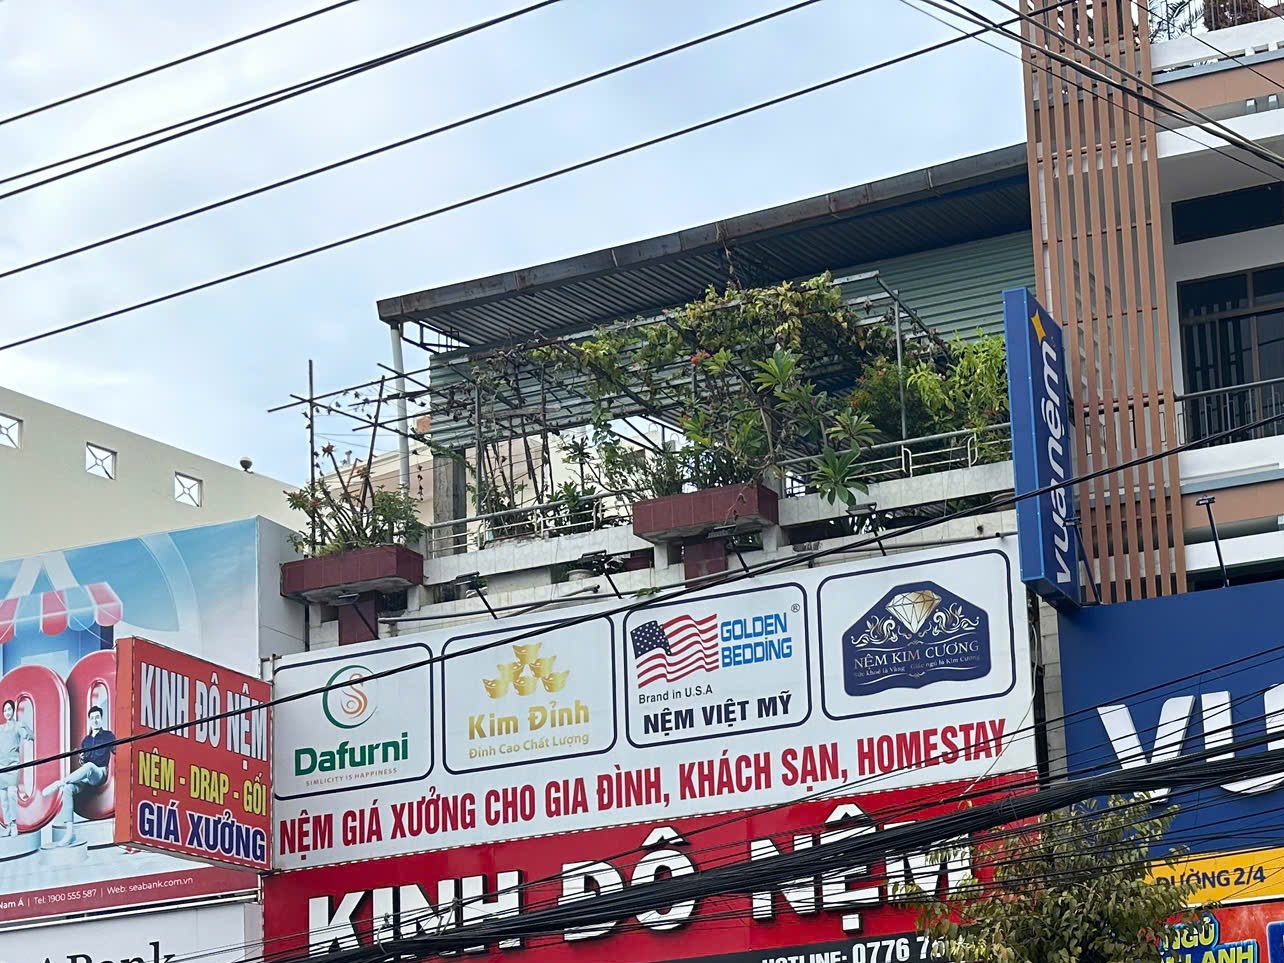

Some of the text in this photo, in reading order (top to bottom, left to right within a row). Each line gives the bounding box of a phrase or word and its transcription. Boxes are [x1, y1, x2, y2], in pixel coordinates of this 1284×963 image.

[720, 612, 788, 643] GOLDEN
[854, 640, 979, 671] NỆM KIM CƯƠNG
[140, 661, 268, 770] KINH ĐÔ NỆM
[638, 684, 713, 705] Brand in U.S.A
[643, 690, 792, 737] NỆM VIỆT MỸ
[468, 699, 590, 740] Kim Đỉnh
[294, 731, 409, 777] Dafurni
[138, 747, 267, 817] NỆM DRAP GỐI
[279, 718, 1006, 861] NỆM GIÁ XƯỞNG CHO GIA ĐÌNH, KHÁCH SẠN, HOMESTAY
[137, 799, 267, 864] GIÁ XƯỞNG
[47, 893, 66, 903] 1900
[67, 891, 82, 901] 555
[82, 888, 97, 899] 587
[308, 869, 522, 962] KINH
